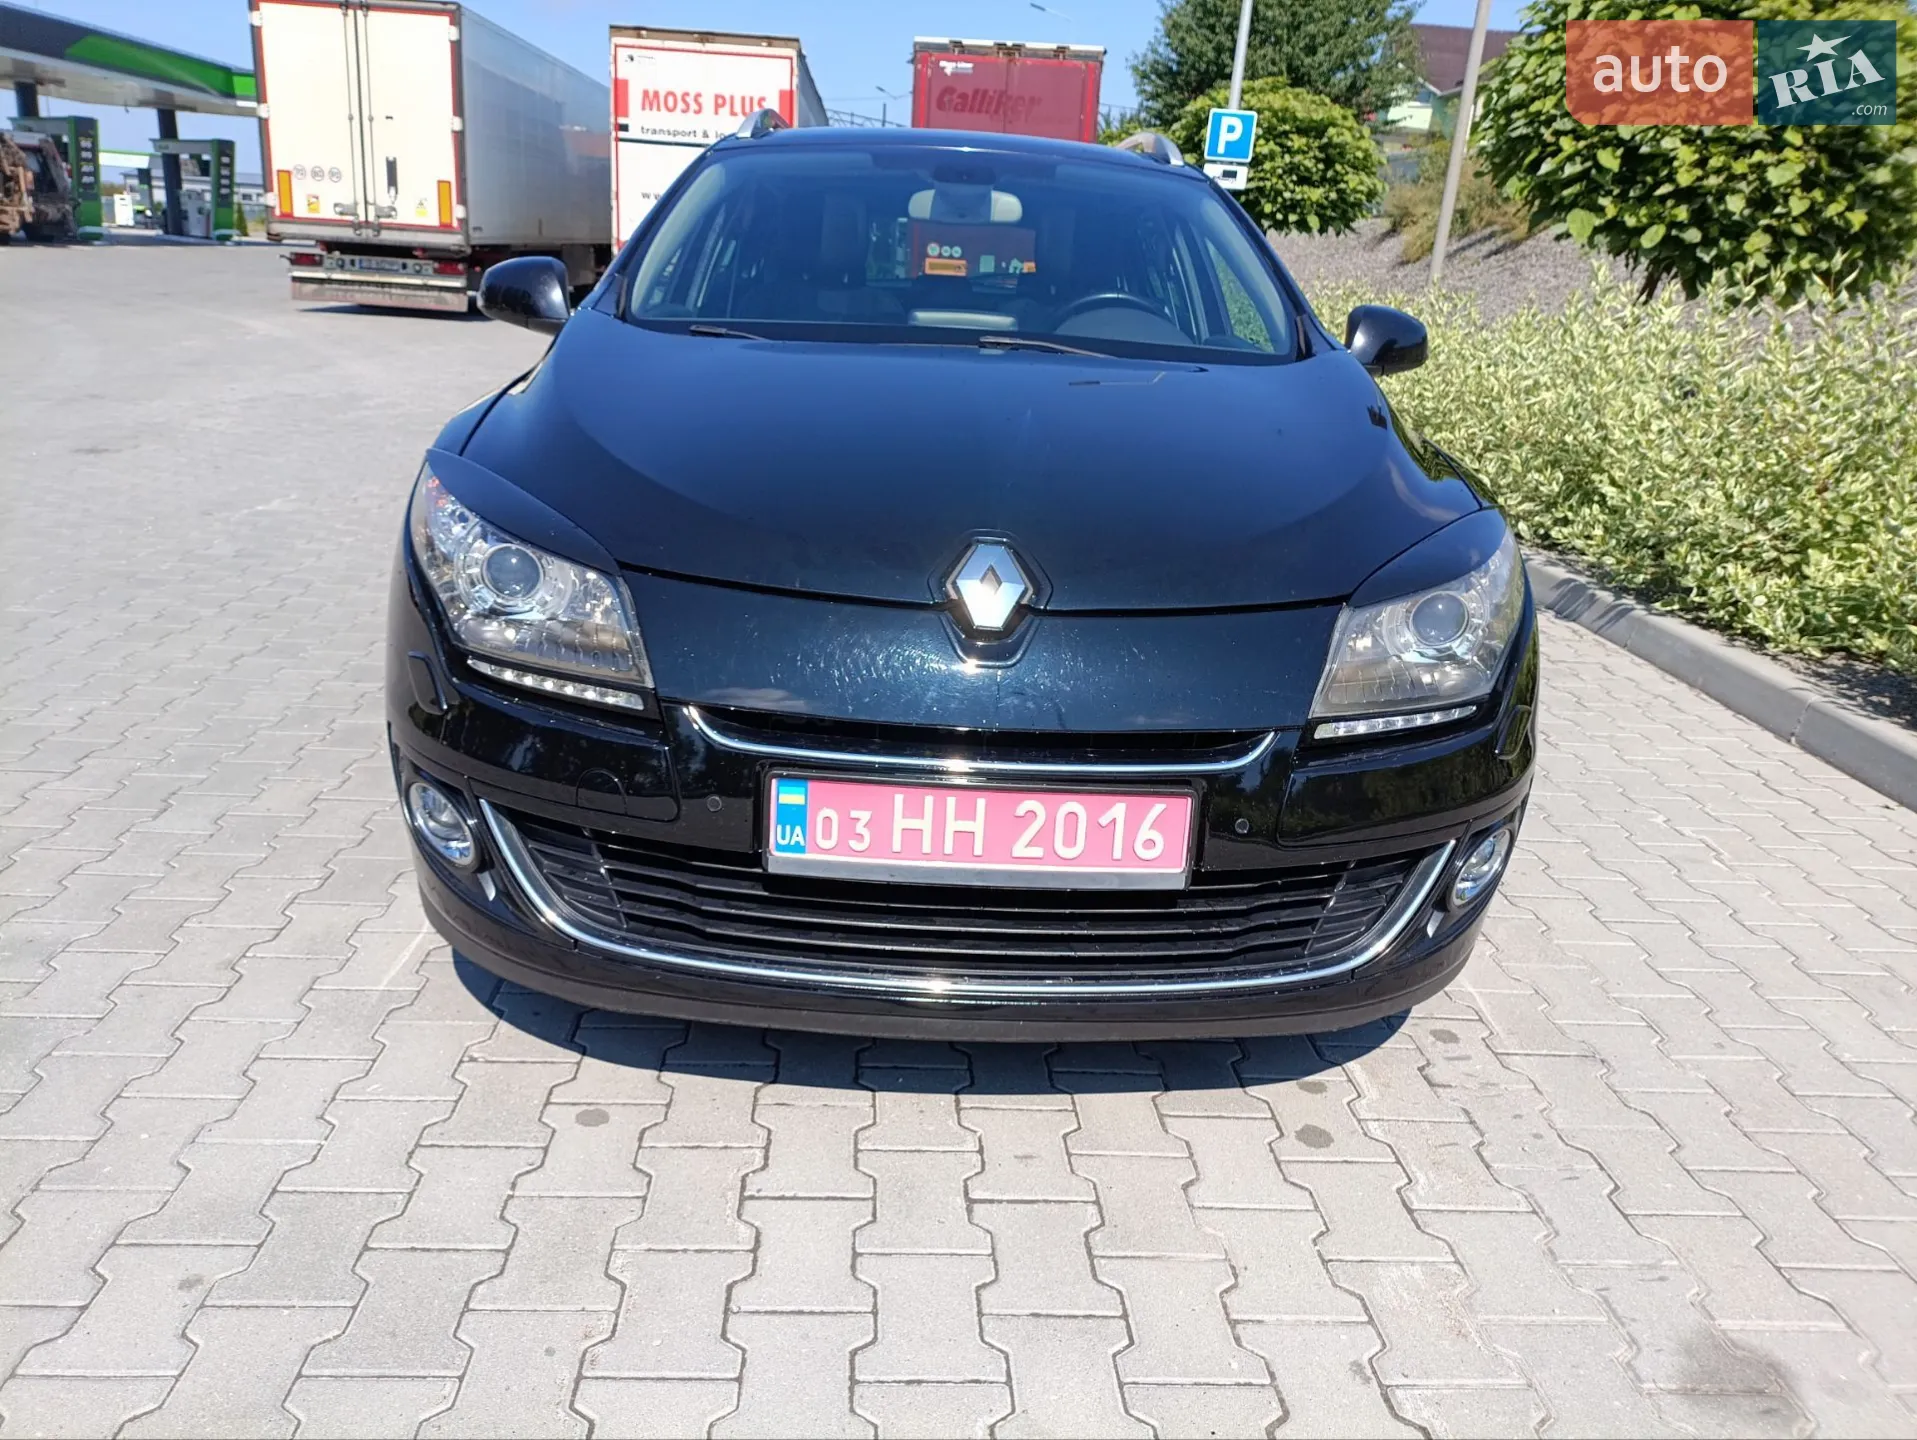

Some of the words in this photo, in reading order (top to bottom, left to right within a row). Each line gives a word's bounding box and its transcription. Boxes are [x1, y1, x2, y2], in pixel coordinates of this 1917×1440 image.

[641, 89, 703, 115] MOSS
[714, 94, 767, 118] PLUS
[936, 85, 1043, 123] Galliker
[640, 125, 698, 138] transport
[702, 129, 710, 139] &
[1217, 115, 1243, 154] P
[776, 824, 806, 846] UA
[815, 808, 872, 852] 03
[892, 793, 986, 857] HH
[1011, 799, 1167, 861] 2016
